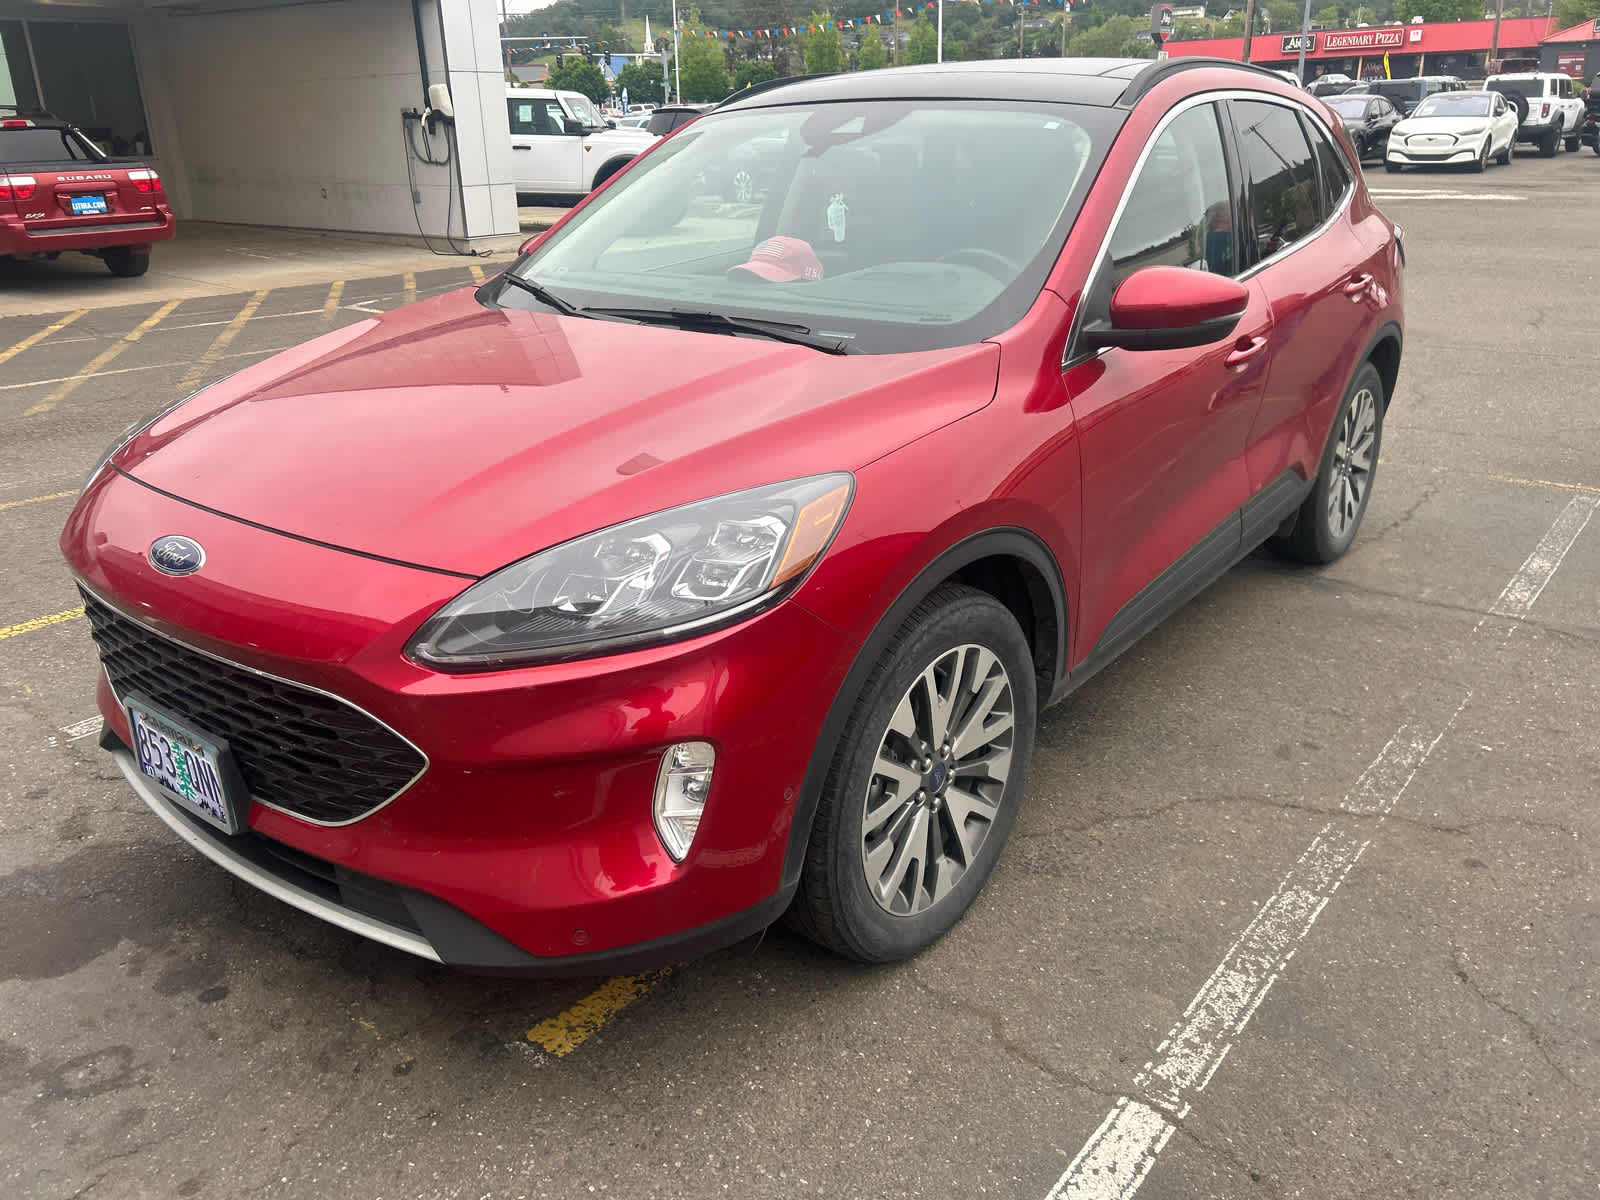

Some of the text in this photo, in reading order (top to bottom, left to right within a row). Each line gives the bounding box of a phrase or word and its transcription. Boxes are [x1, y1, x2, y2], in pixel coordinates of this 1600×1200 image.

[1326, 34, 1374, 47] LEGENDARY
[1375, 32, 1400, 44] PIZZA
[157, 541, 192, 565] Ford
[137, 722, 176, 779] 853
